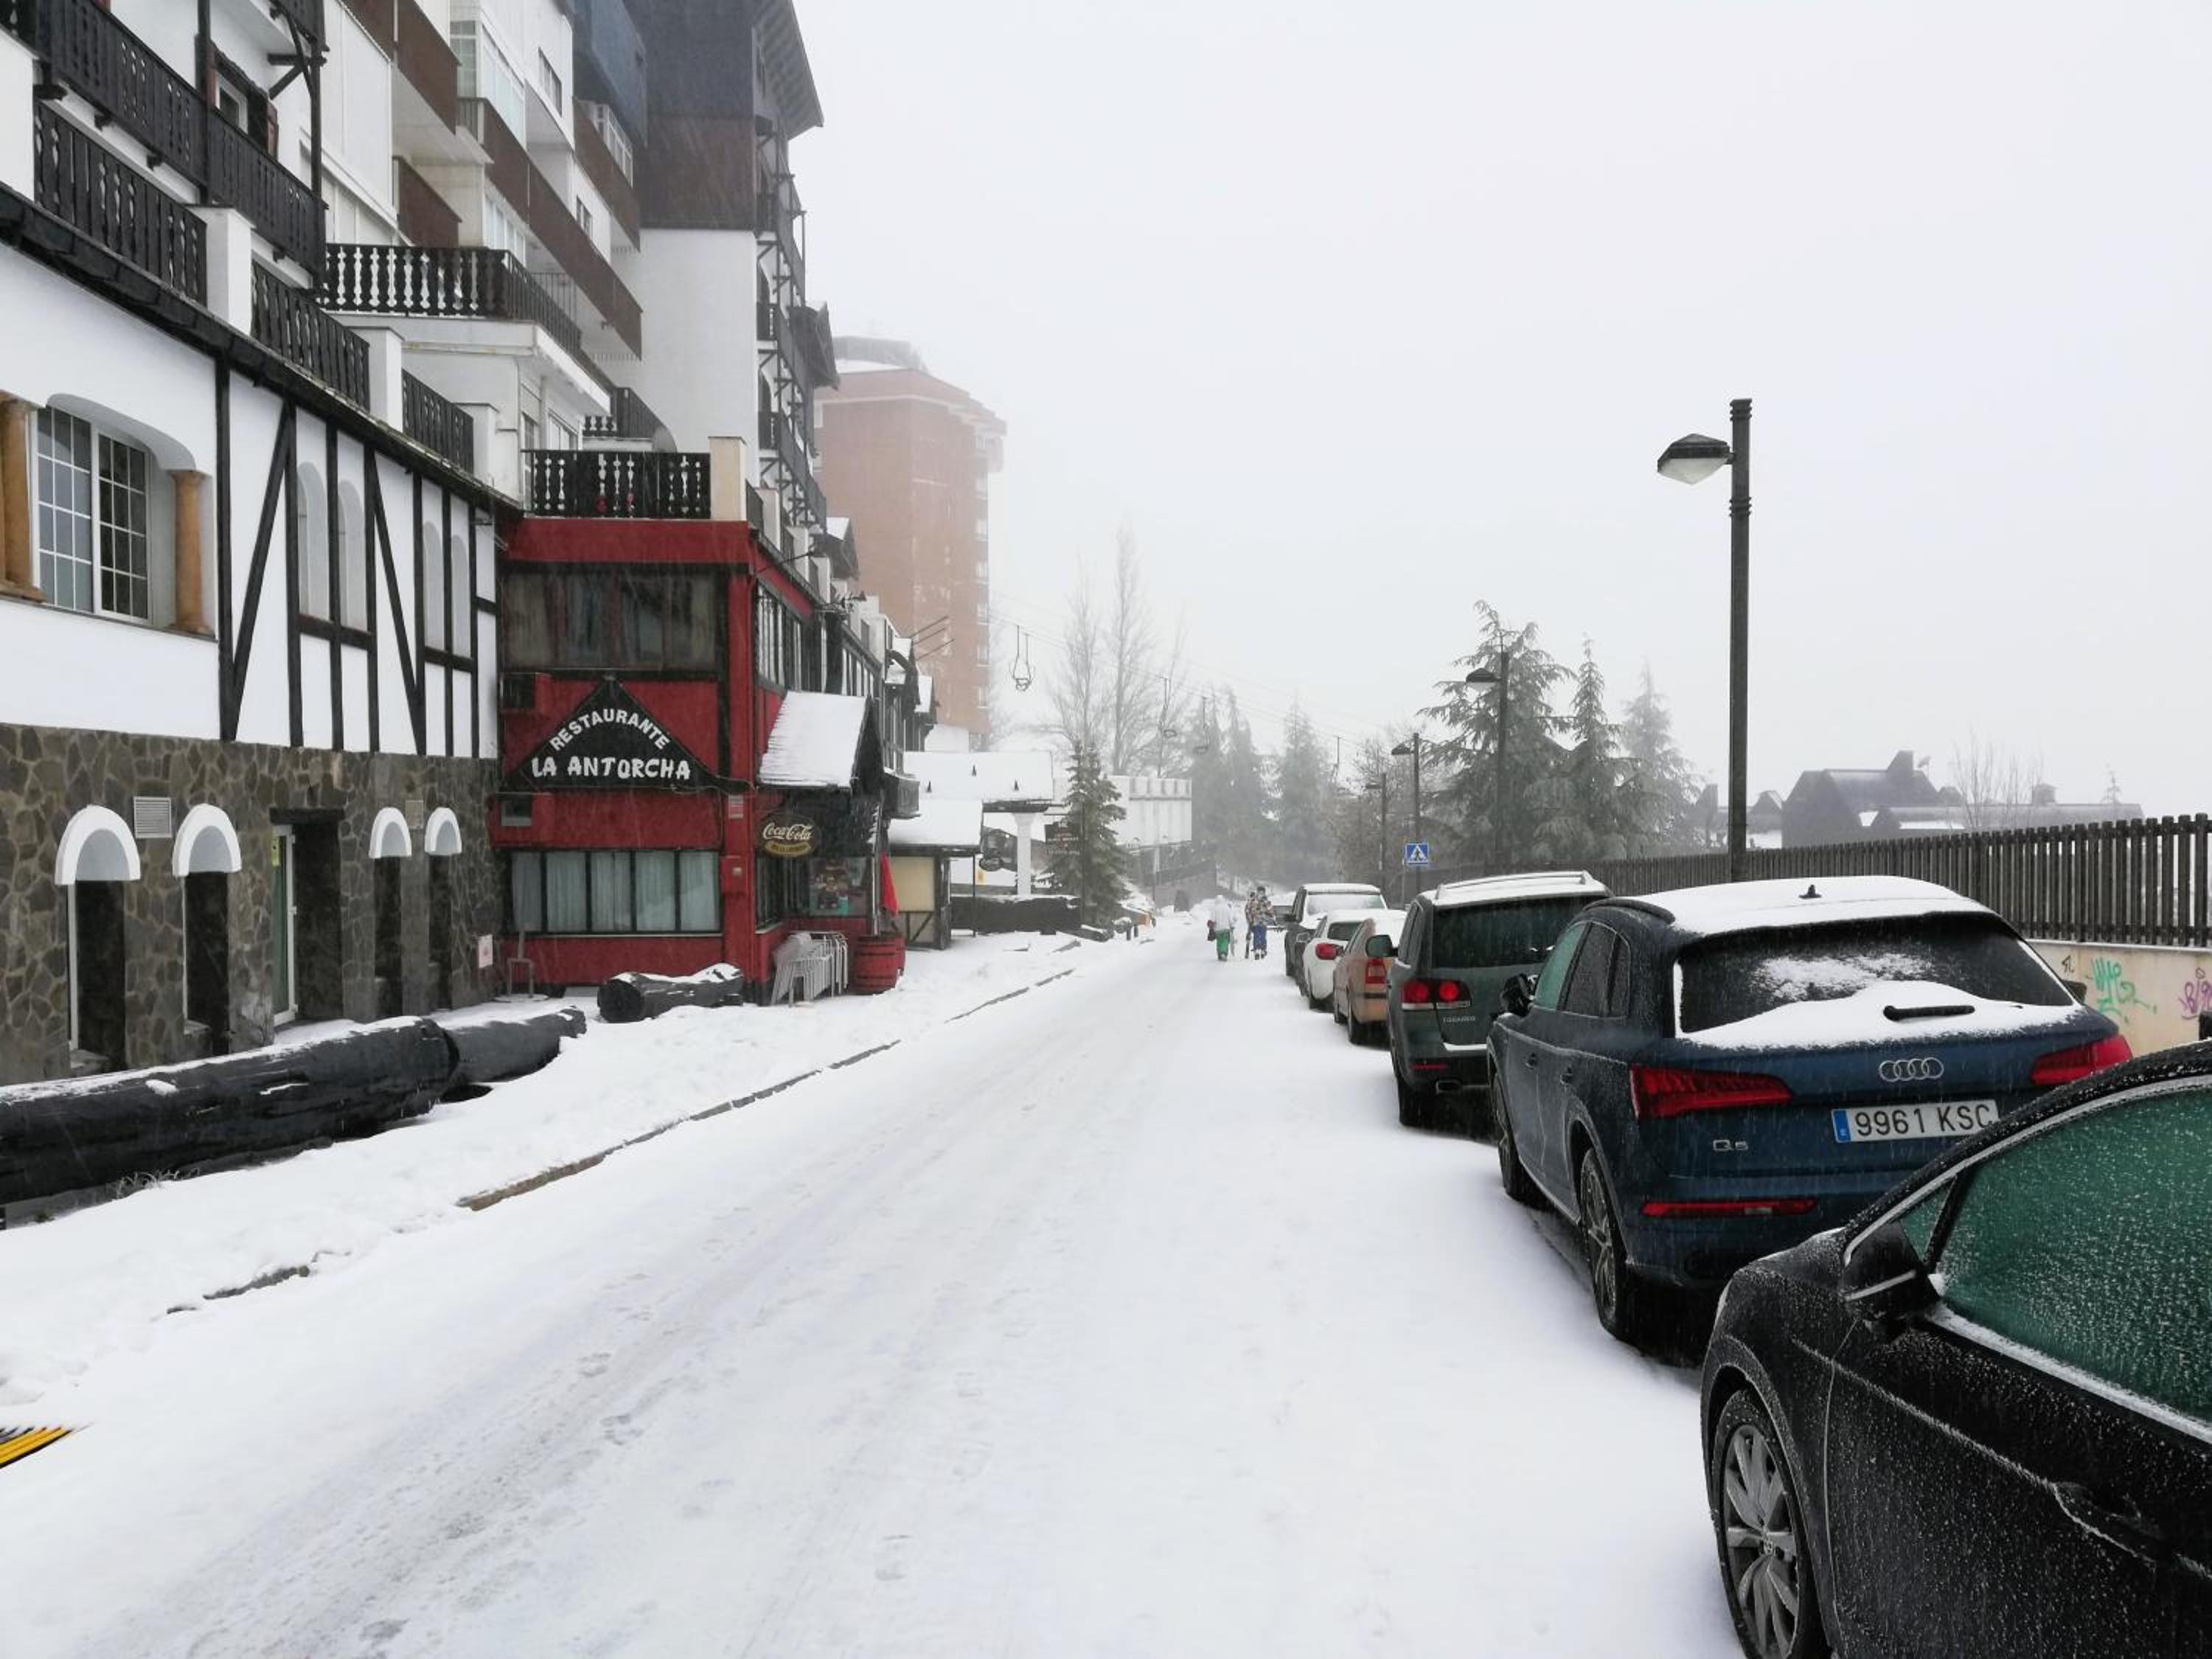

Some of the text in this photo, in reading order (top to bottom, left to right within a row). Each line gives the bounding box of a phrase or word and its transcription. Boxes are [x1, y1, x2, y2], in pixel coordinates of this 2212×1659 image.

[549, 709, 670, 751] RESTAURANTE
[531, 756, 691, 780] LA ANTORCHA
[1854, 1104, 1993, 1136] 9961 KSC
